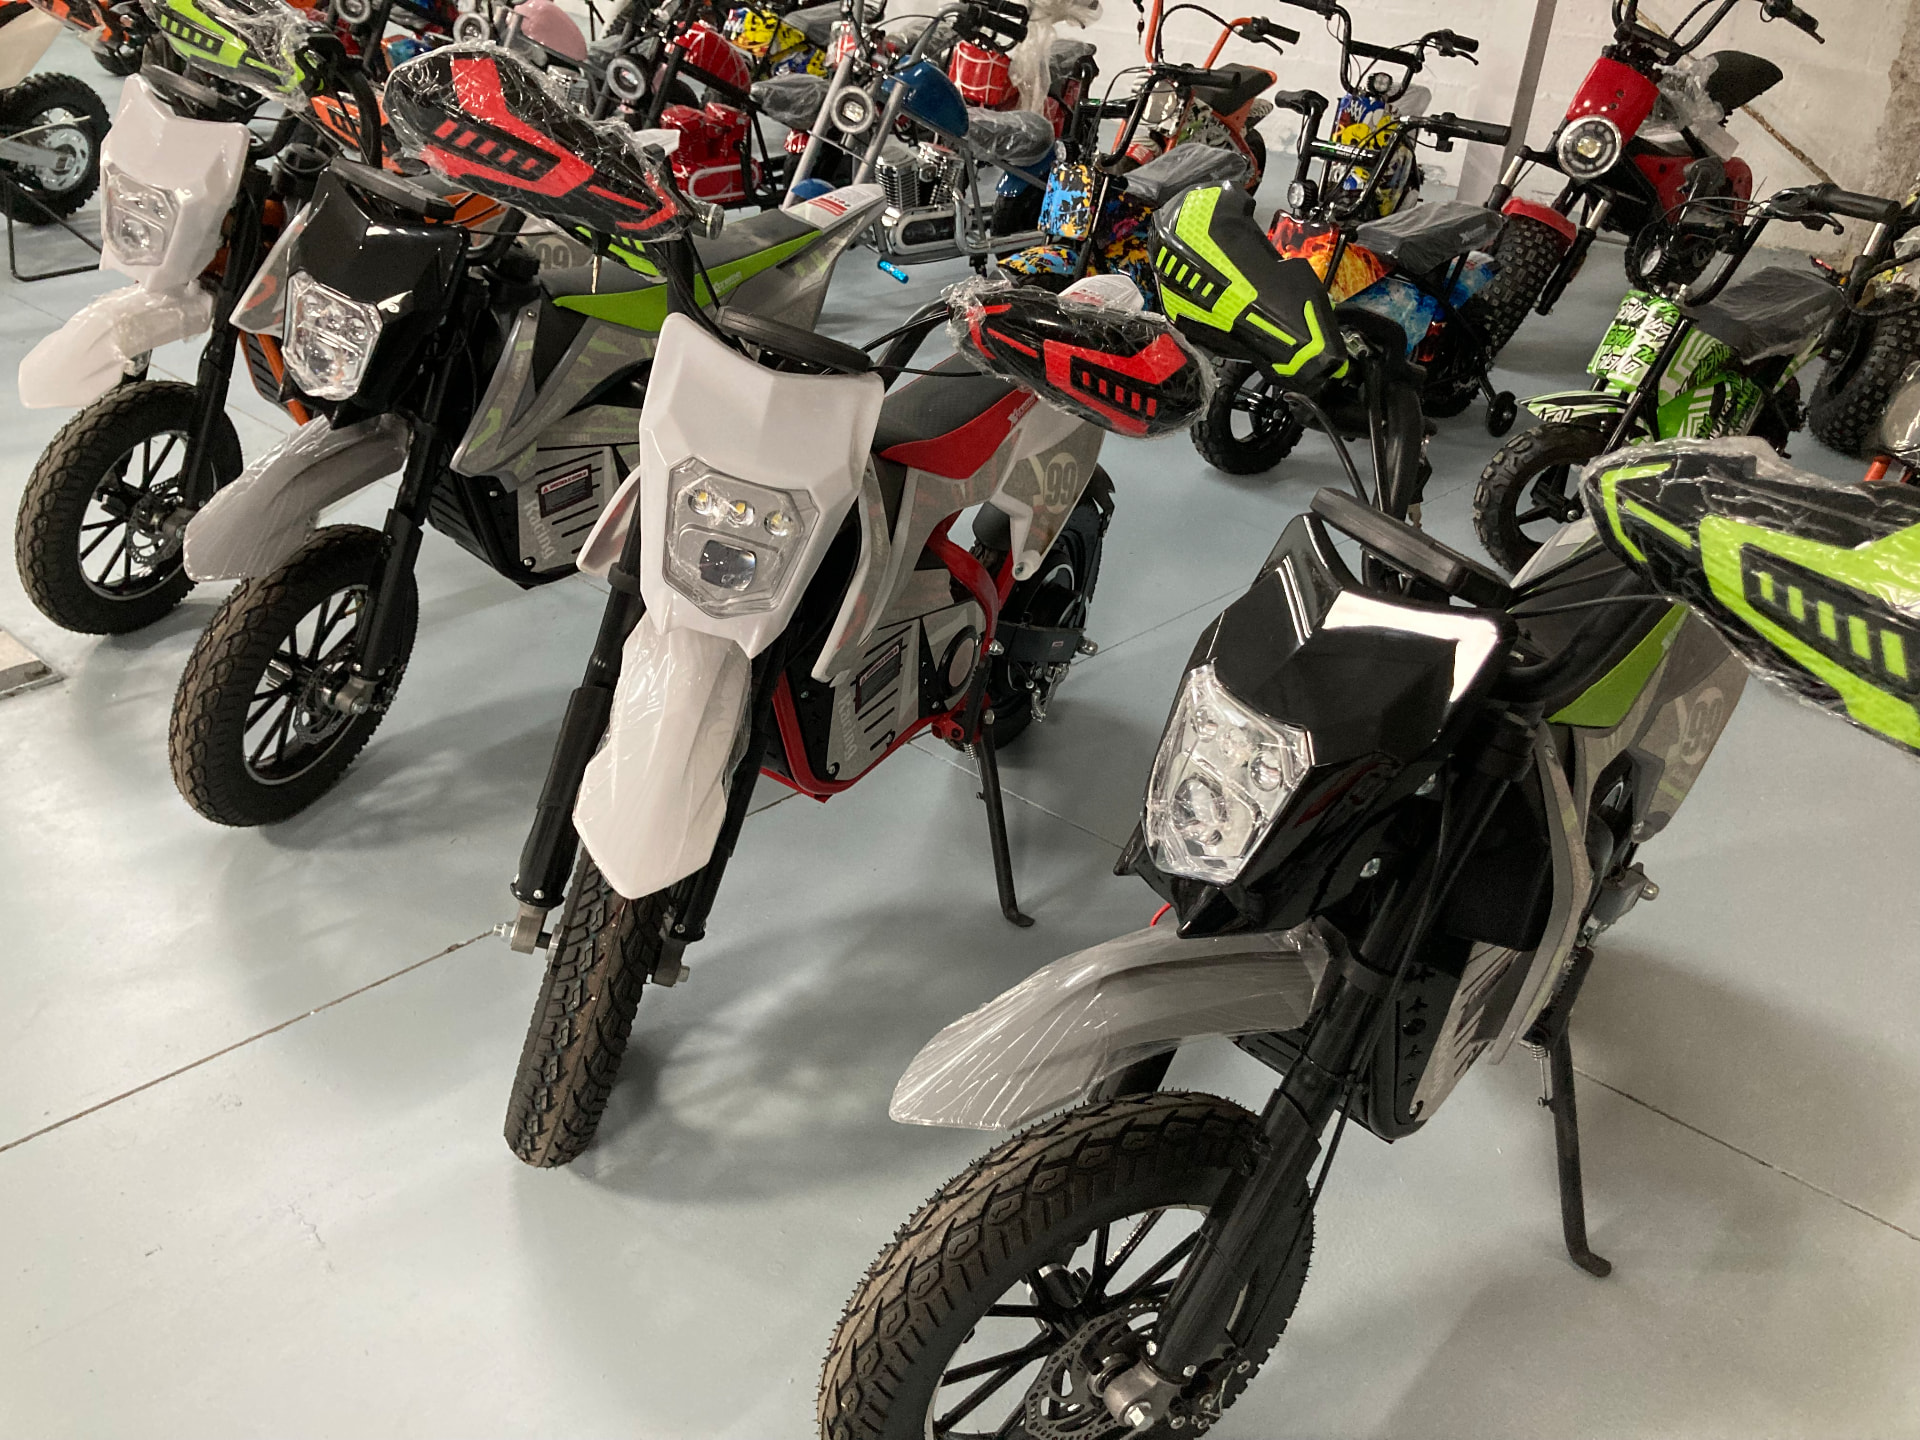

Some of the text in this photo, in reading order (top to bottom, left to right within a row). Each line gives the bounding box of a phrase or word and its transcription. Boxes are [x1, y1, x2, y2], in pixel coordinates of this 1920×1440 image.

[1045, 462, 1077, 507] 99
[524, 499, 557, 560] Racing
[838, 691, 858, 761] Racing
